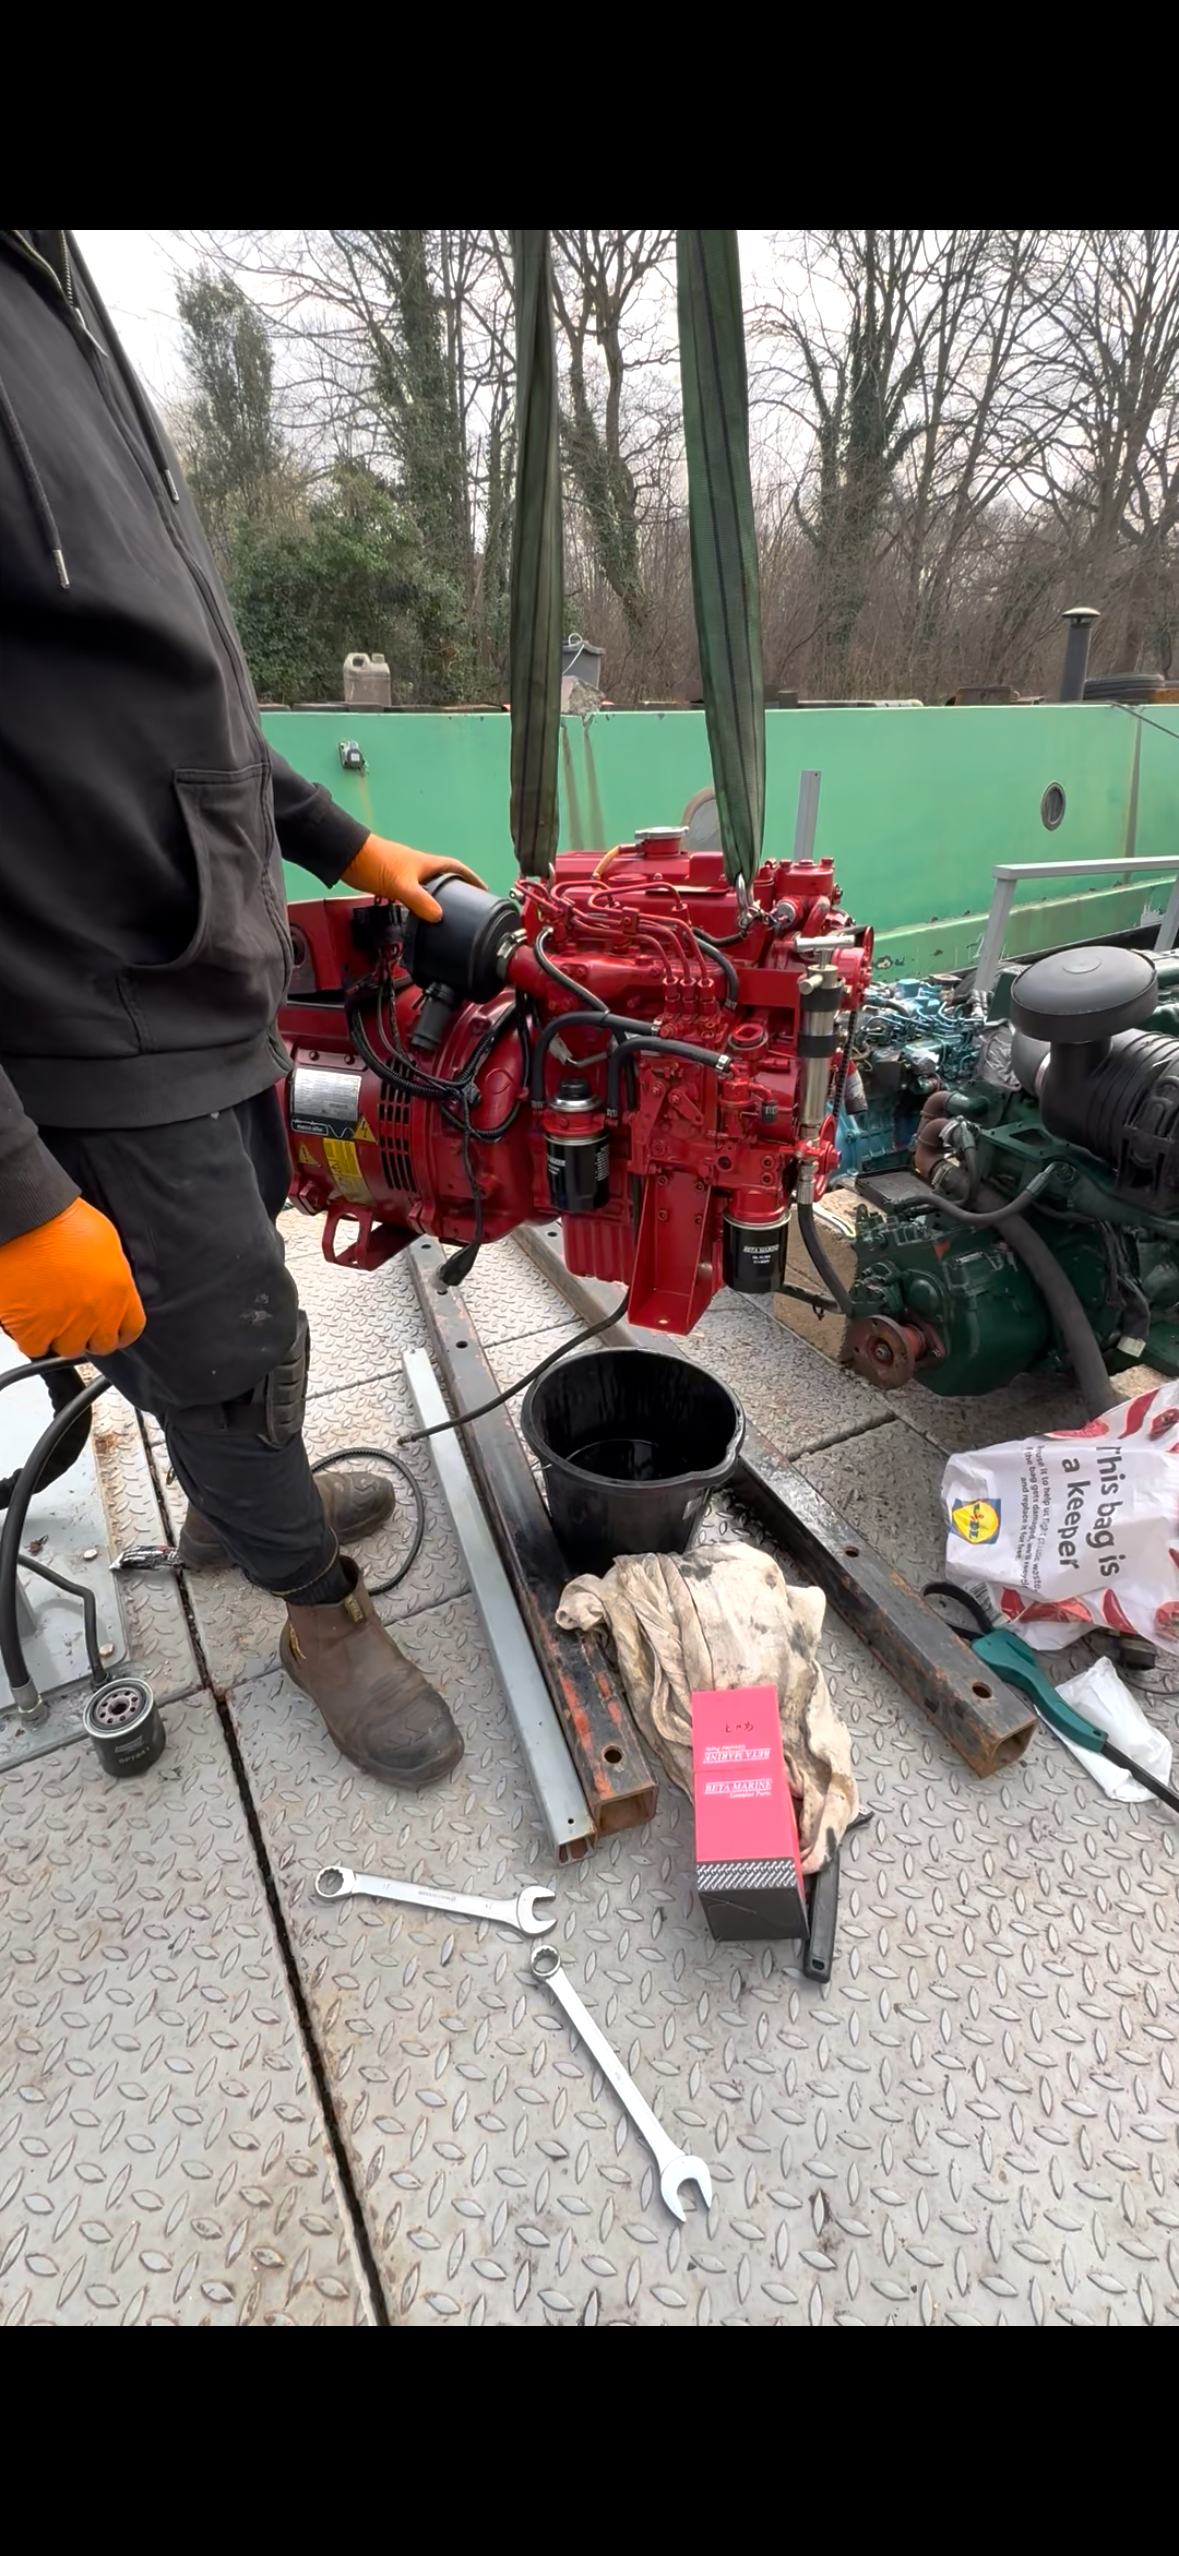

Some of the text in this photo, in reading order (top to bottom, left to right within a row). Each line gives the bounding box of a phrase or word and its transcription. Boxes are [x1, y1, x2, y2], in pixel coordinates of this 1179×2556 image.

[1029, 1466, 1037, 1483] bag
[1041, 1476, 1049, 1486] to
[1020, 1477, 1029, 1493] and
[1030, 1484, 1039, 1503] gets
[1042, 1487, 1051, 1505] help
[1021, 1494, 1030, 1524] replace
[1043, 1506, 1050, 1517] us
[1057, 1457, 1091, 1569] a keeper
[1086, 1446, 1126, 1577] This bag is
[1027, 1503, 1040, 1542] damaged,
[1019, 1531, 1027, 1543] for
[704, 1748, 771, 1763] BETA MARINE
[705, 1779, 772, 1793] BETA MARINE
